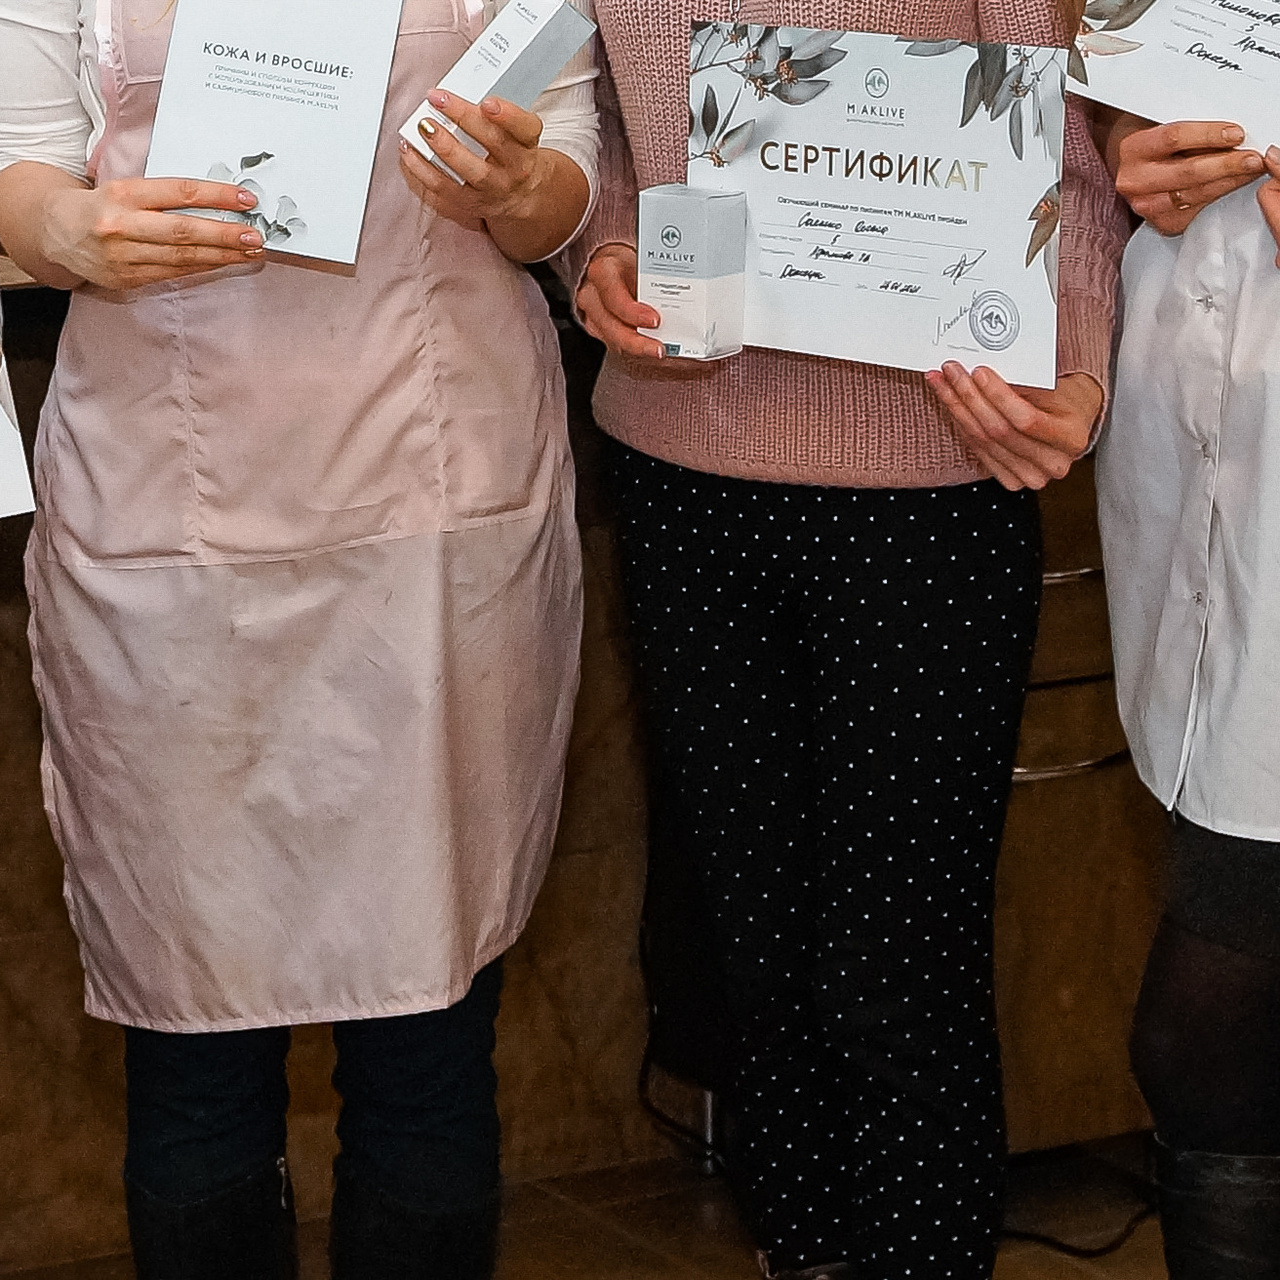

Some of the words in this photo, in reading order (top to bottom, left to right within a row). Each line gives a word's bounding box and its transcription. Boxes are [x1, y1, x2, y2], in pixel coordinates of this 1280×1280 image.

[203, 42, 250, 61] КОЖА
[255, 51, 267, 65] И
[271, 54, 355, 80] ВРОСШИЕ:
[760, 140, 988, 193] СЕРТИФИКАТ
